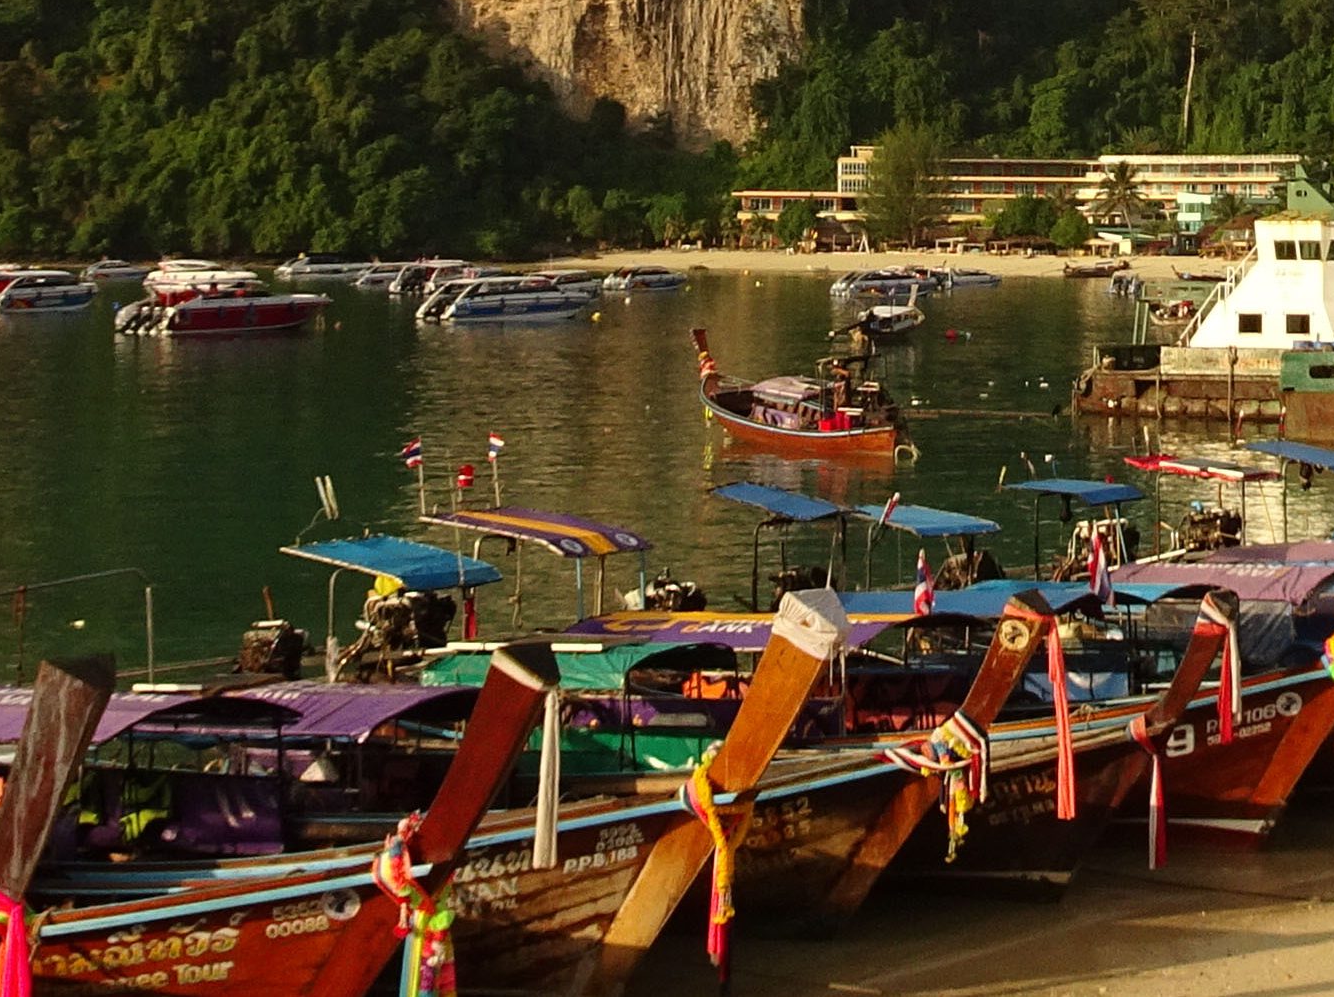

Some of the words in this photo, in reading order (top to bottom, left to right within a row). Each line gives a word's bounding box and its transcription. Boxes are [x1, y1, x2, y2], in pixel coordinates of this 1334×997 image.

[1243, 703, 1277, 724] 106
[1165, 723, 1195, 758] 9
[173, 960, 236, 985] Tour
